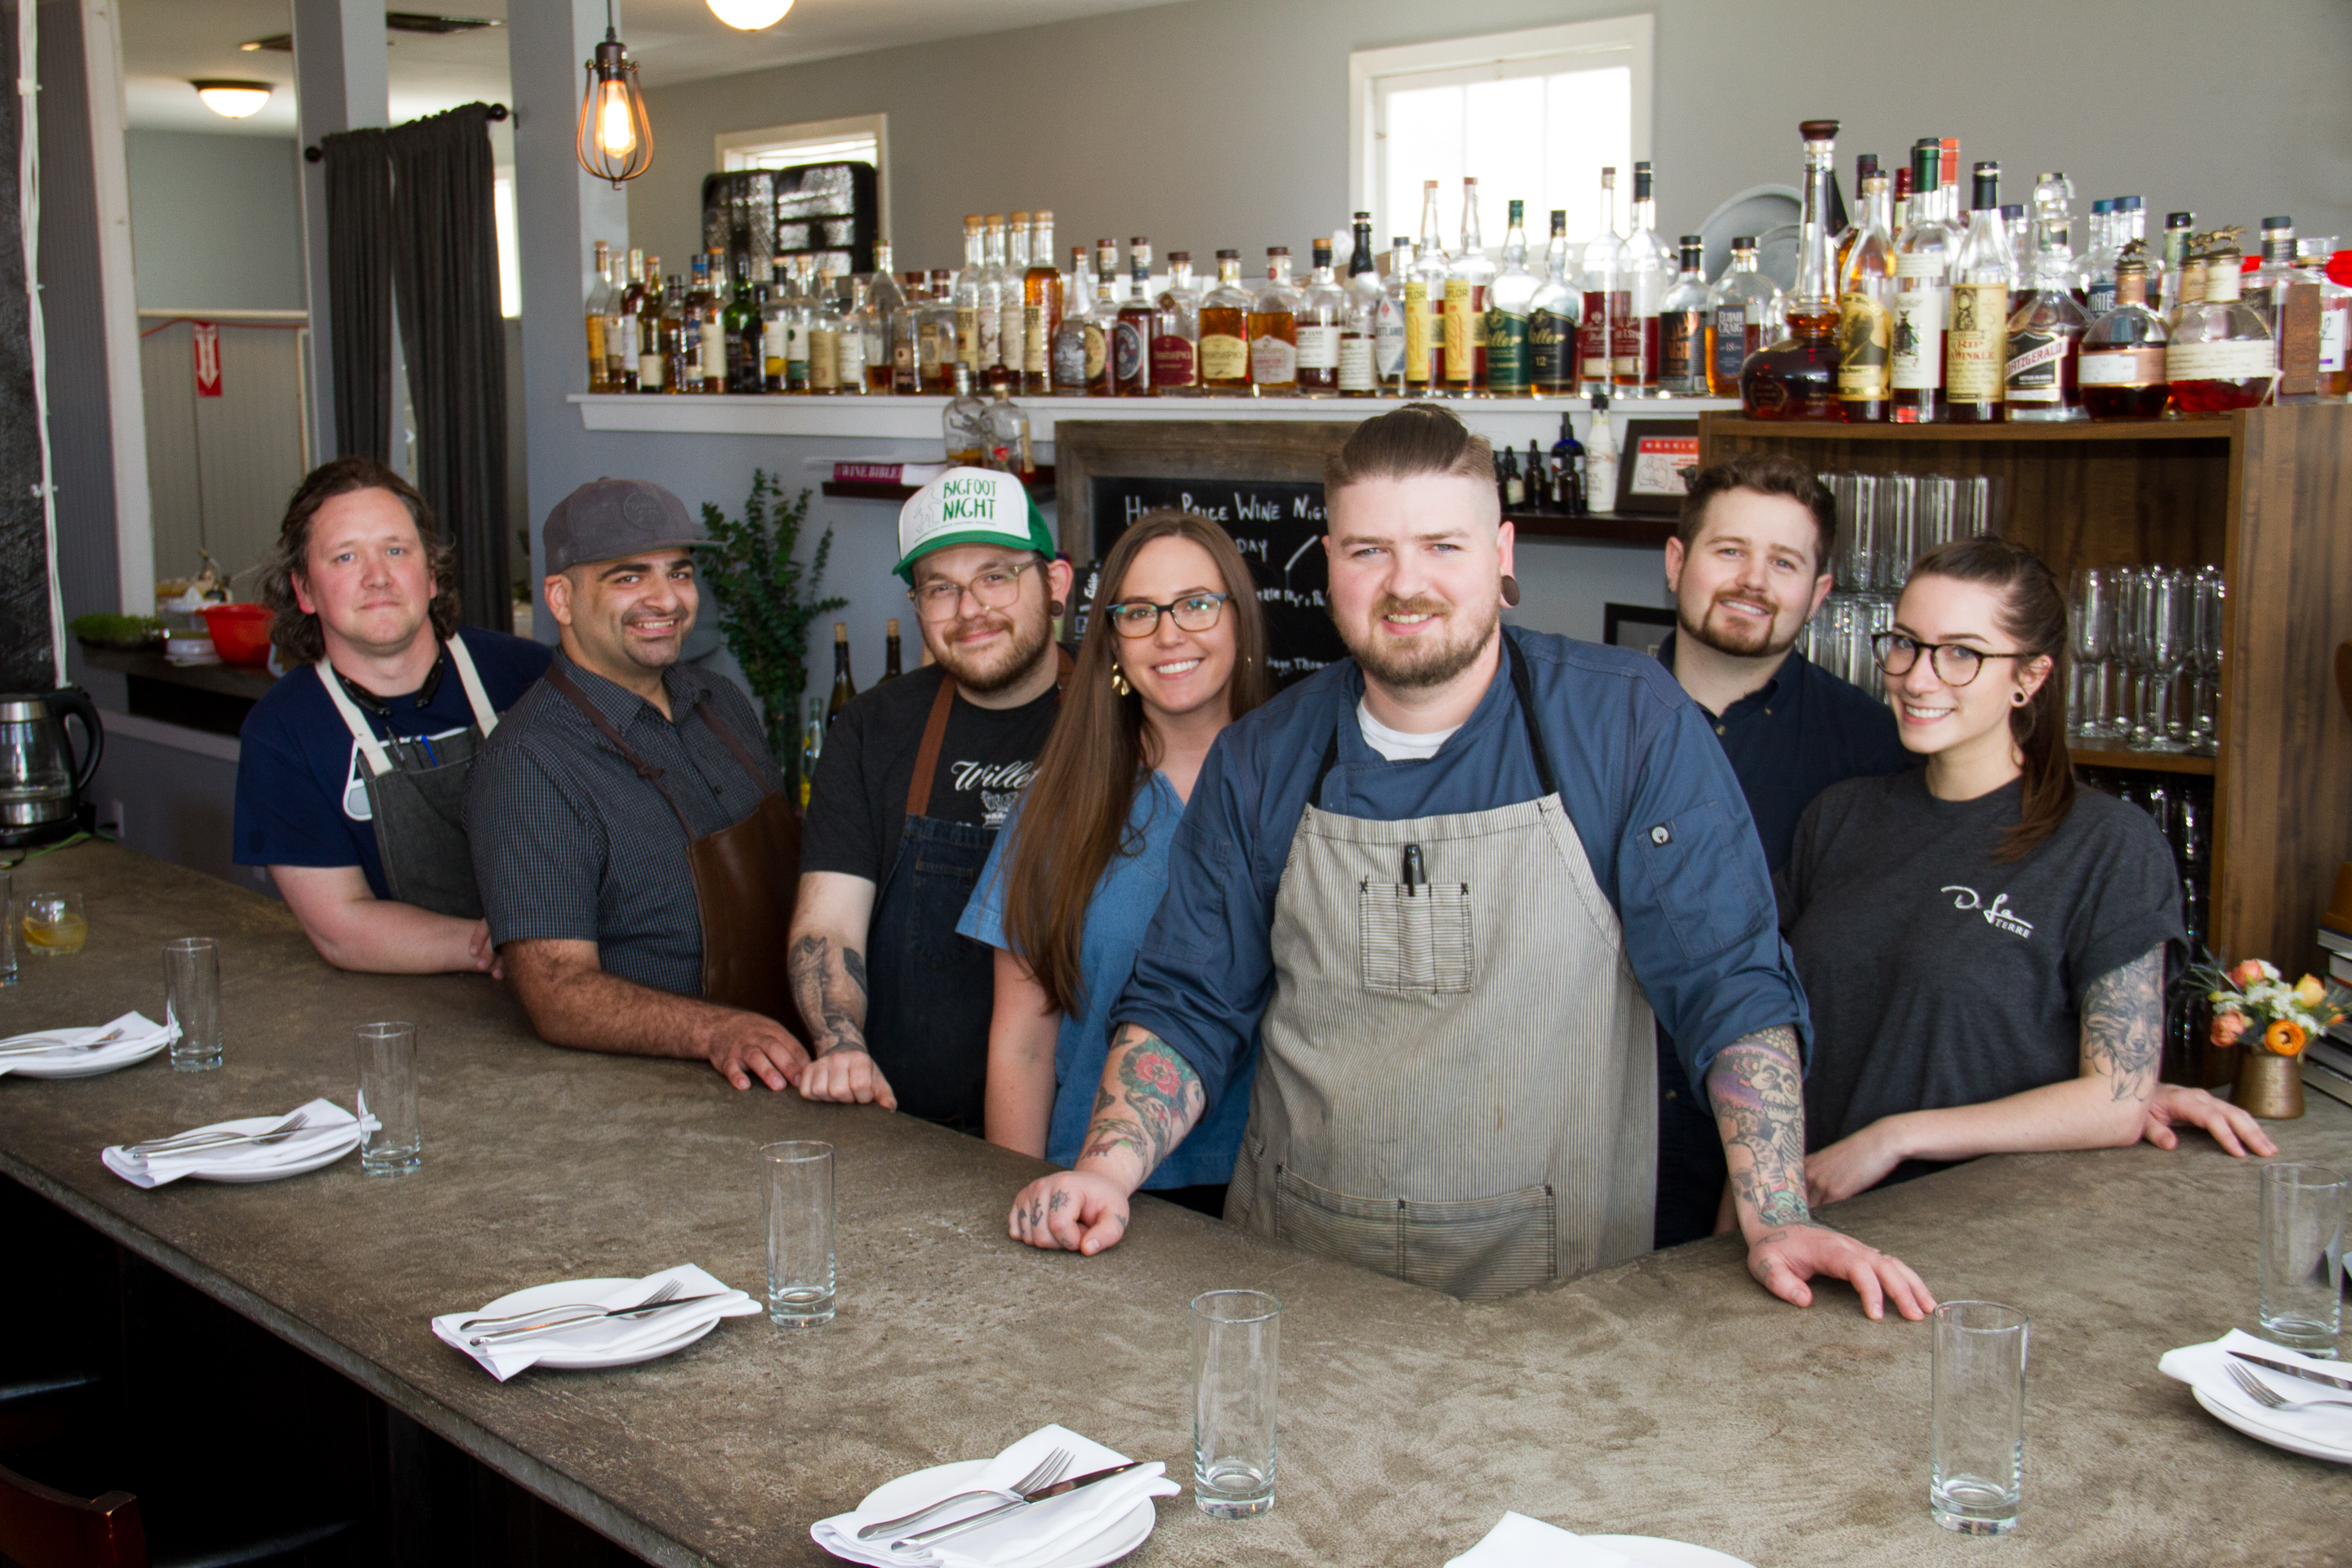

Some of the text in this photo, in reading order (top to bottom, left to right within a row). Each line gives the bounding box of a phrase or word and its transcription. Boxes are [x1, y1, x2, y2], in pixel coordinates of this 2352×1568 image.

[1717, 310, 1744, 323] ELIJAH
[1717, 322, 1744, 335] CRAIG
[1725, 342, 1735, 353] 18
[1536, 356, 1547, 367] 12
[1645, 441, 1697, 449] WARNIN
[842, 466, 898, 479] WINE BIBLE
[943, 479, 996, 499] BIGFOOT
[942, 497, 996, 522] NIGHT
[1182, 492, 1229, 521] PRICE
[1234, 492, 1280, 522] WINE
[1293, 493, 1327, 519] NIG
[1236, 537, 1267, 563] DAY
[1995, 918, 2032, 939] TERRE
